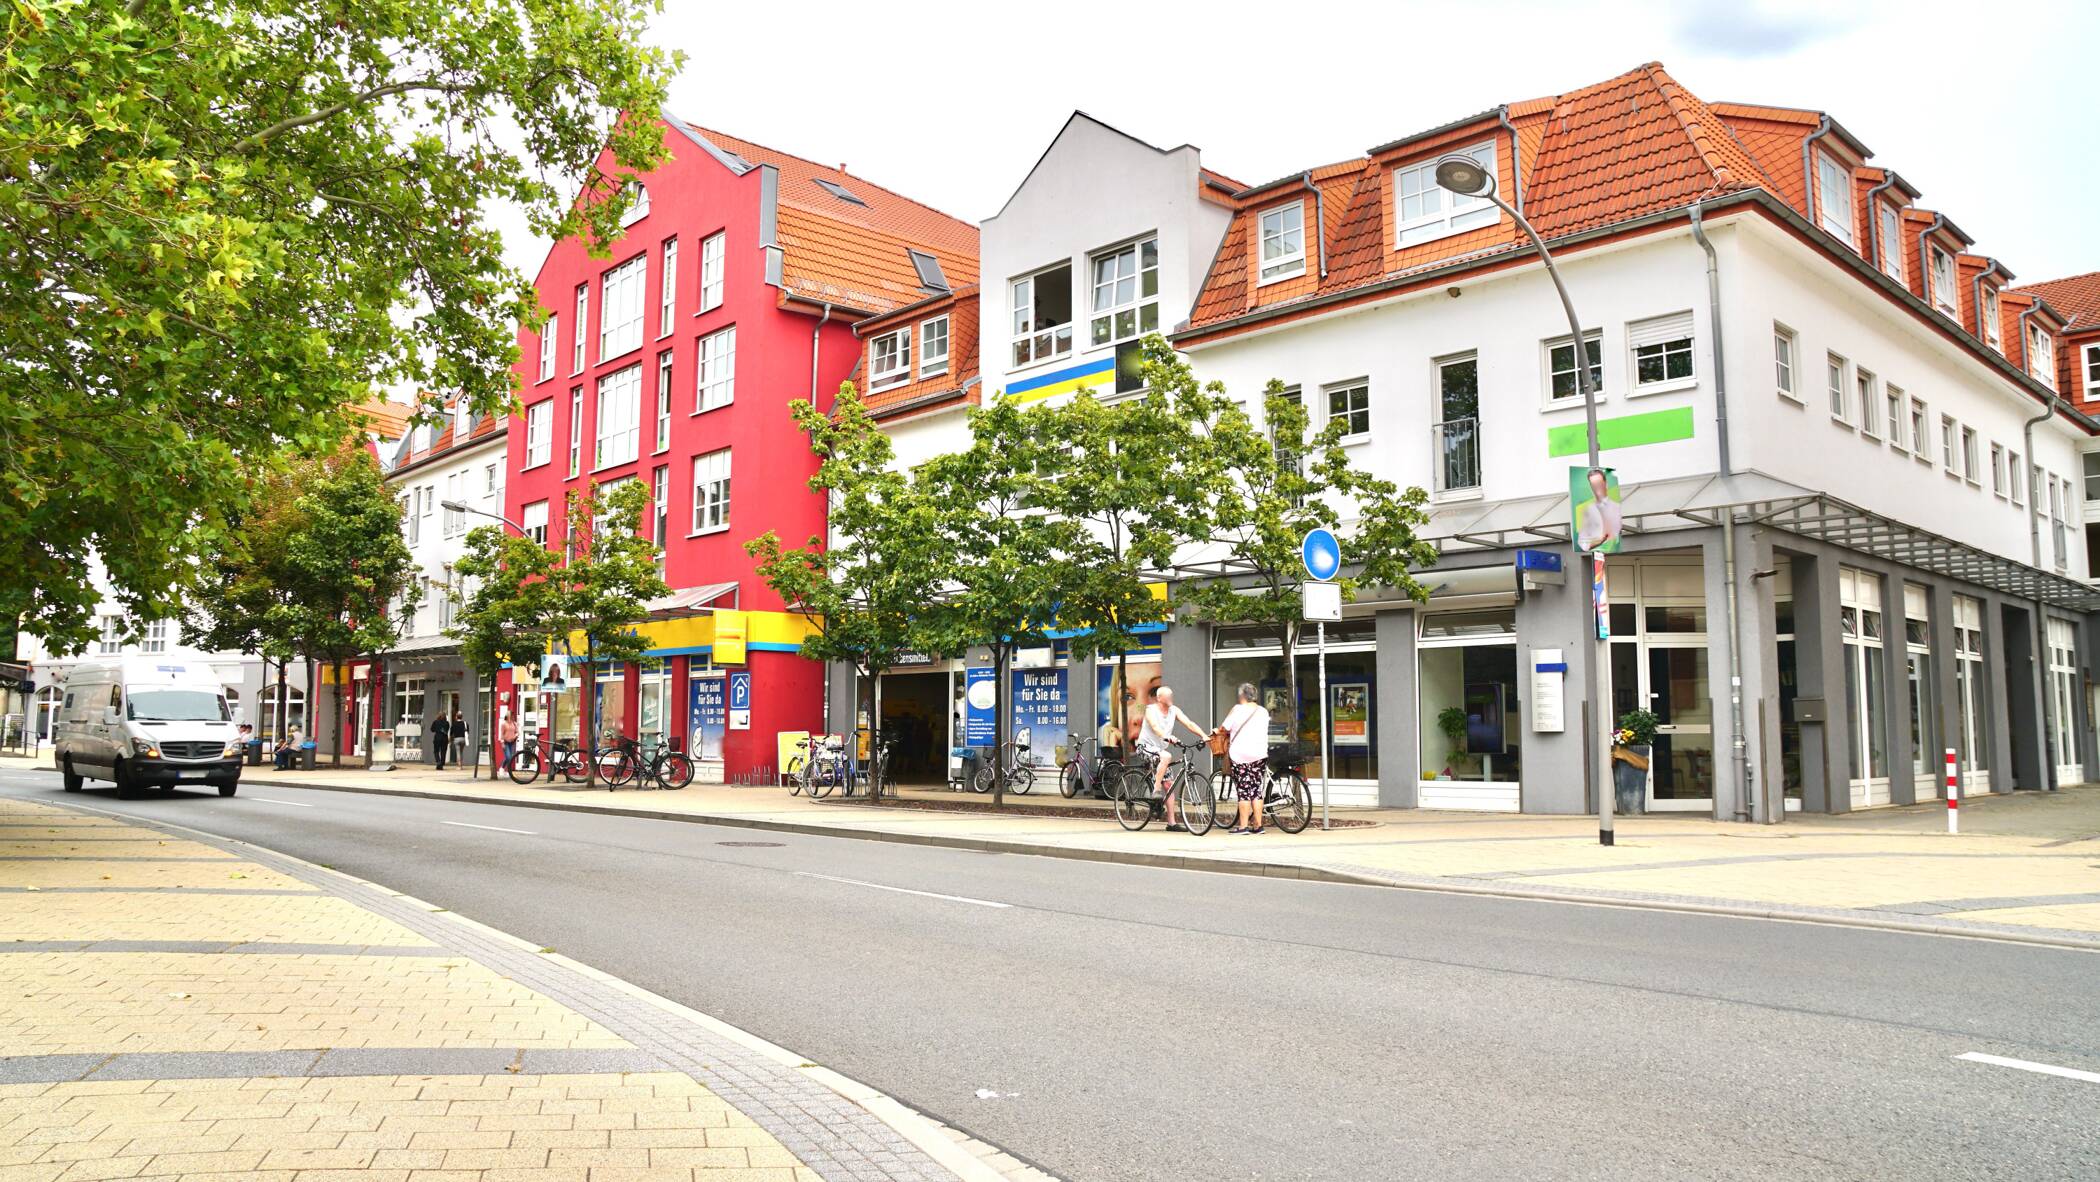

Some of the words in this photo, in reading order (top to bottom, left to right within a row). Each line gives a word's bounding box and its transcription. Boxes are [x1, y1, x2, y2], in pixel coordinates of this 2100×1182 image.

[1024, 674, 1038, 686] Wir
[1040, 672, 1058, 686] sind
[699, 682, 708, 693] Wir
[709, 681, 721, 693] sind
[698, 694, 706, 705] für
[706, 693, 715, 705] Sie
[715, 693, 722, 705] da
[736, 686, 745, 704] P
[1022, 688, 1034, 701] für
[1035, 688, 1048, 701] Sie
[1050, 688, 1060, 701] da
